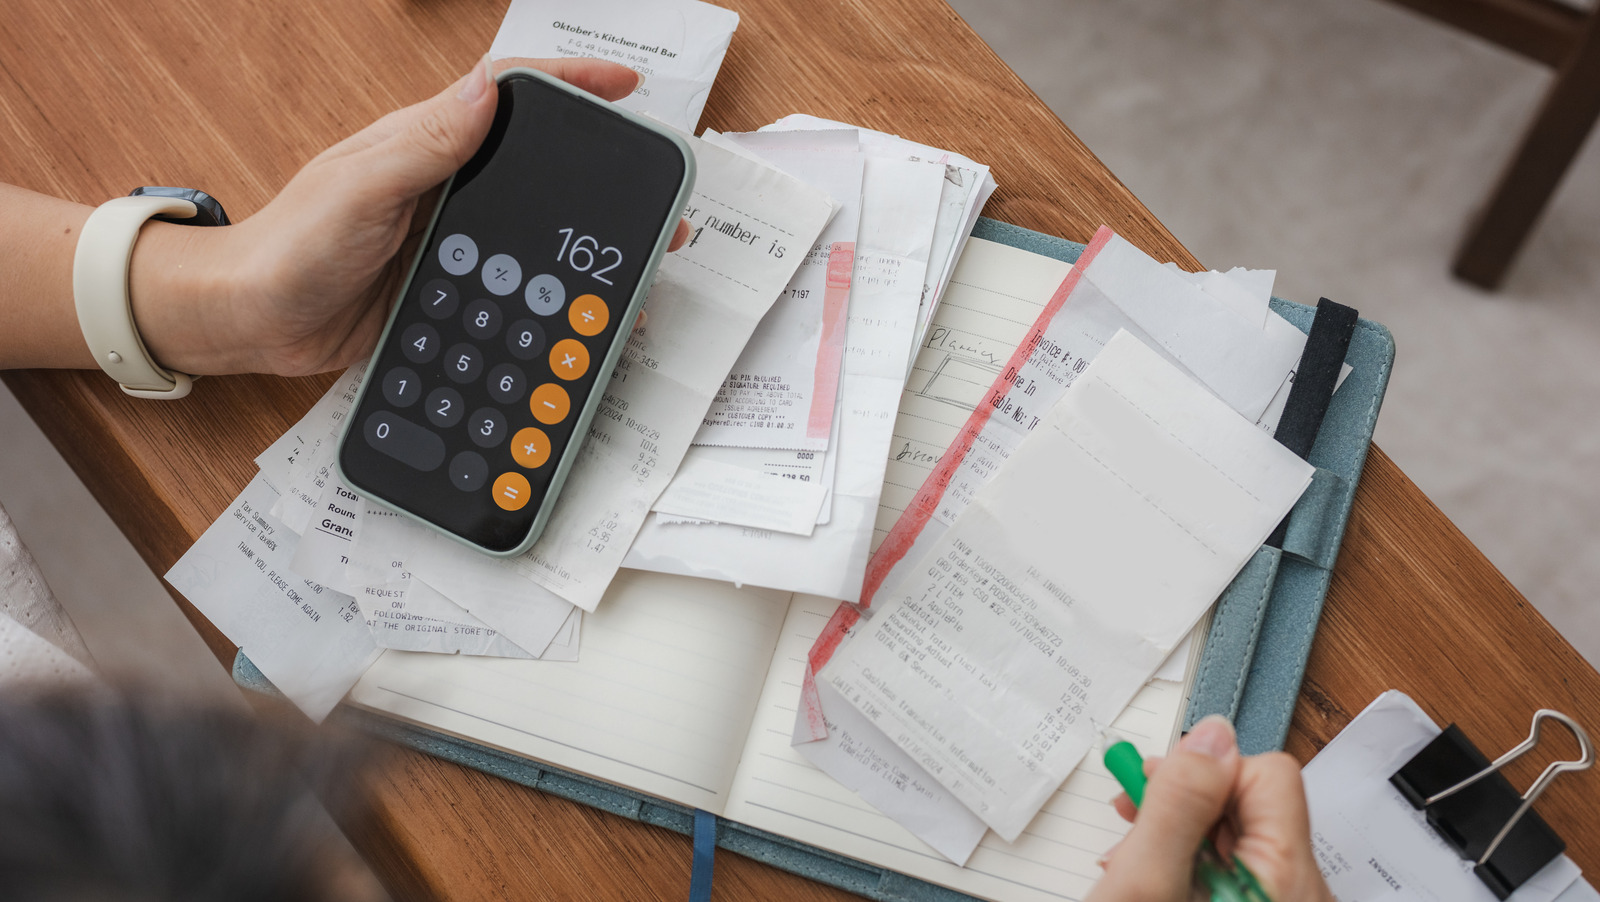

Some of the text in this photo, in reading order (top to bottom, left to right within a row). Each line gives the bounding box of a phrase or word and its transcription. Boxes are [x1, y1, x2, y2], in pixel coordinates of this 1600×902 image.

[552, 19, 677, 58] Oktober's Kitchen and Bar
[555, 45, 578, 58] Taipan
[610, 49, 624, 58] PJU
[704, 211, 762, 247] number
[768, 239, 787, 259] is
[452, 248, 464, 262] C
[556, 227, 622, 286] 162
[791, 290, 810, 299] 7197
[432, 290, 532, 348] 7 8 9
[1029, 328, 1064, 358] Invoice
[413, 336, 514, 392] 4 5 6
[621, 348, 659, 369] 110-3436
[1019, 350, 1045, 370] Staff:
[1039, 353, 1061, 371] Date:
[729, 381, 790, 391] SIGNATURE REQUIRED
[753, 374, 781, 383] REQUIRED
[1003, 366, 1038, 396] Dine In
[398, 379, 494, 436] 1 2 3
[988, 391, 1014, 414] Table
[1011, 406, 1029, 424] No:
[376, 422, 390, 439] 0
[624, 418, 660, 440] 10:02:29
[637, 452, 657, 467] 9.25
[638, 439, 662, 455] TOTA
[630, 463, 650, 478] 0.95
[335, 487, 359, 501] Total
[232, 508, 258, 532] Service
[240, 500, 277, 535] Tax Summary
[586, 539, 605, 554] 1.47
[952, 538, 971, 556] INV#
[390, 560, 402, 568] OR
[947, 551, 989, 586] OrderKey#
[236, 541, 322, 622] THANK YOU, PLEASE COME AGAIN
[365, 587, 404, 598] REQUEST
[1042, 579, 1075, 607] INVOICE
[336, 606, 354, 623] 1.92
[347, 601, 360, 615] Tax
[902, 596, 940, 629] Subtotal
[927, 584, 935, 592] 2
[943, 597, 965, 616] Corn
[383, 621, 399, 630] THE
[404, 623, 448, 634] ORIGINAL
[454, 626, 480, 636] STORE
[927, 567, 1092, 705] QTY ITEM TOTA
[936, 557, 953, 573] ORD
[952, 570, 969, 586] #69
[1007, 618, 1055, 658] 01/10/2024
[1054, 656, 1092, 688] 10:09:30
[880, 621, 927, 661] Mastercard
[873, 630, 944, 690] TOTAL 6% Service
[919, 594, 1076, 725] 1 ApplePie 4.10
[887, 613, 1052, 752] Rounding Adjust 0.01
[895, 607, 926, 634] TakeOut
[928, 633, 952, 654] Total
[977, 673, 998, 692] Tax)
[1035, 721, 1060, 743] 17.34
[831, 676, 882, 721] DATE & TIME
[859, 667, 998, 787] Cashless transaction information
[1368, 856, 1401, 891] INVOICE
